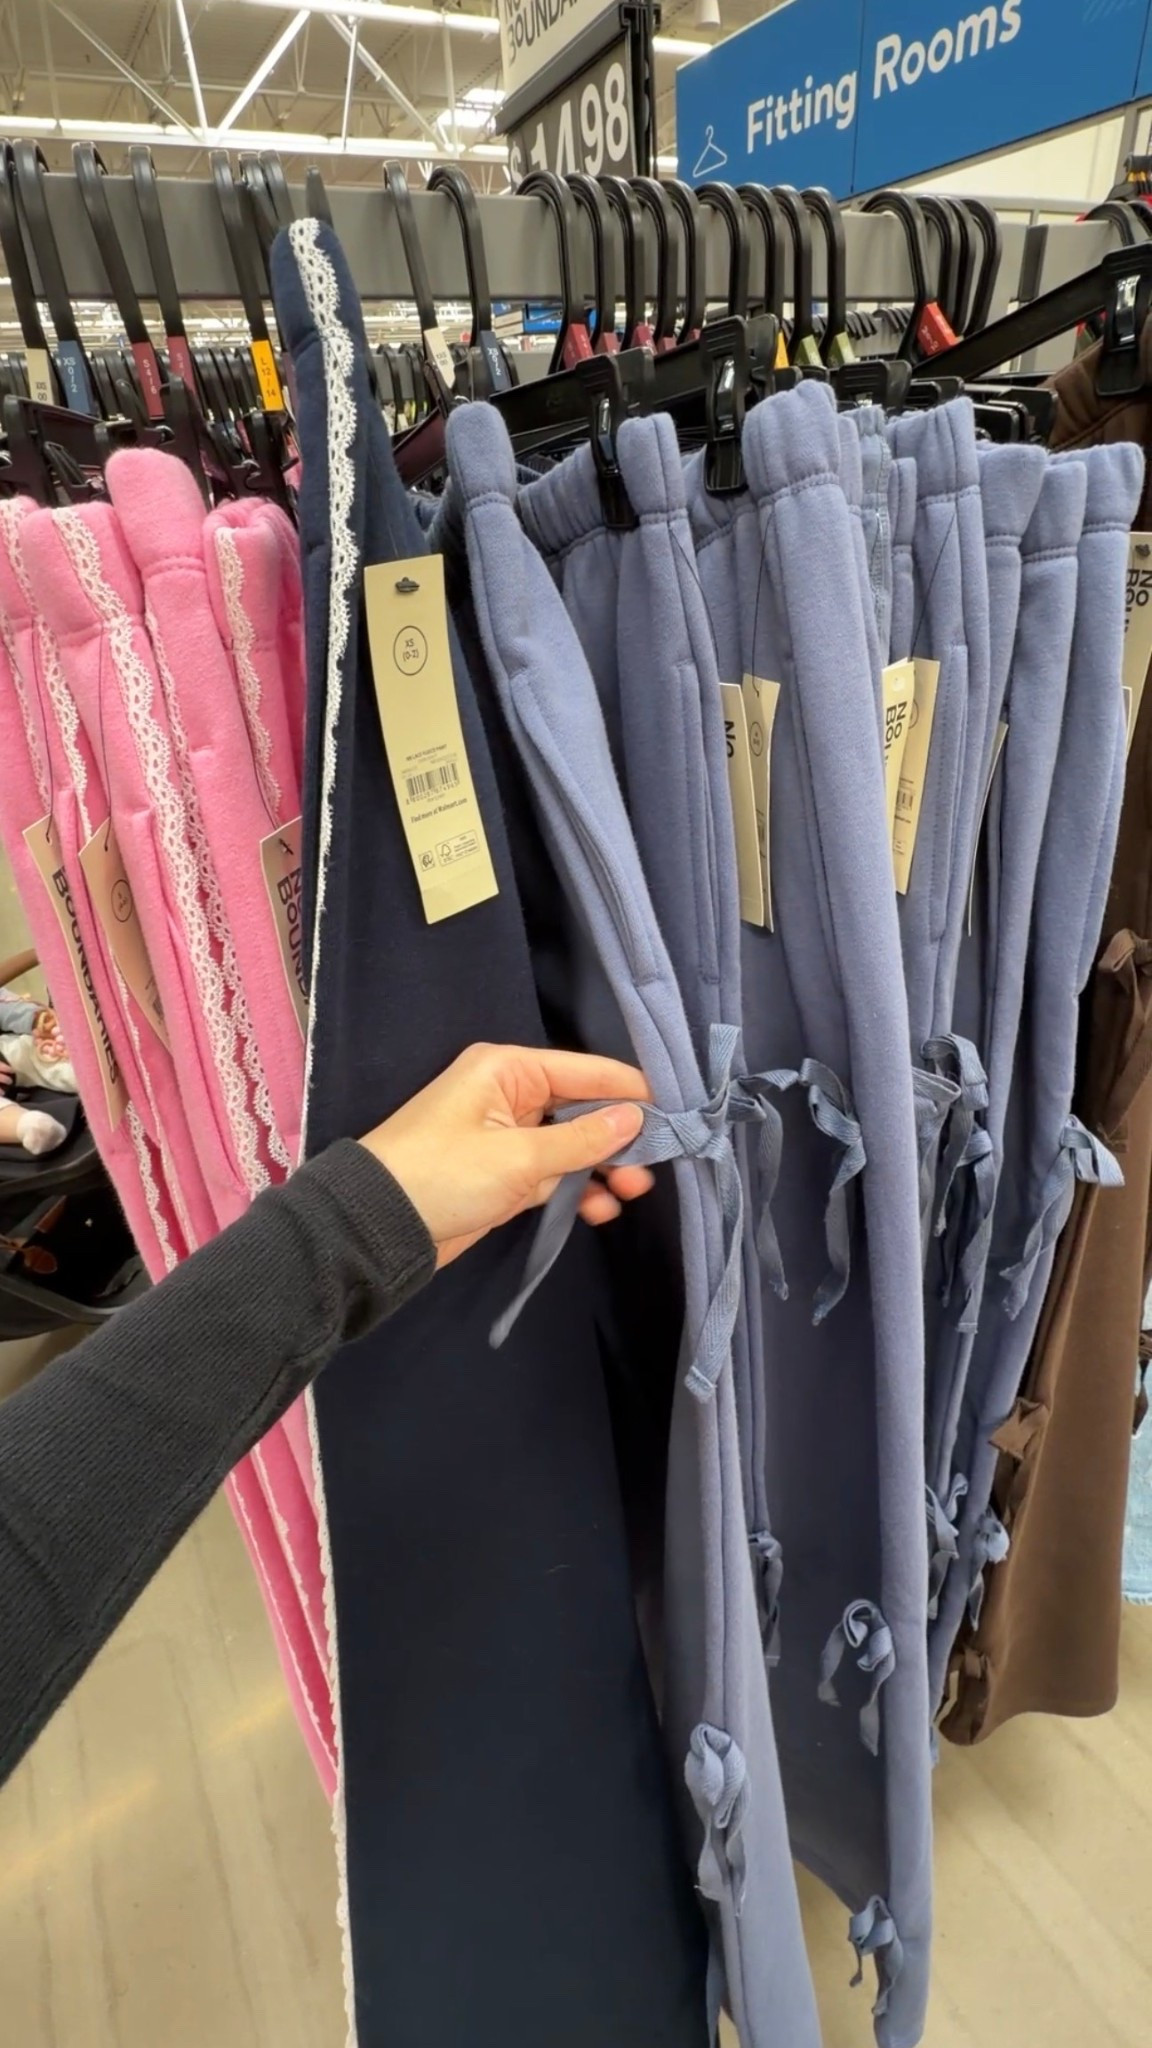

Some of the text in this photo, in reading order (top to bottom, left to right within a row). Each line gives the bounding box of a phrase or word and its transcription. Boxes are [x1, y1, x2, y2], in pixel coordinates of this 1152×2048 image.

[747, 0, 1022, 154] Fitting Rooms
[63, 357, 76, 366] XS
[896, 701, 908, 739] NO
